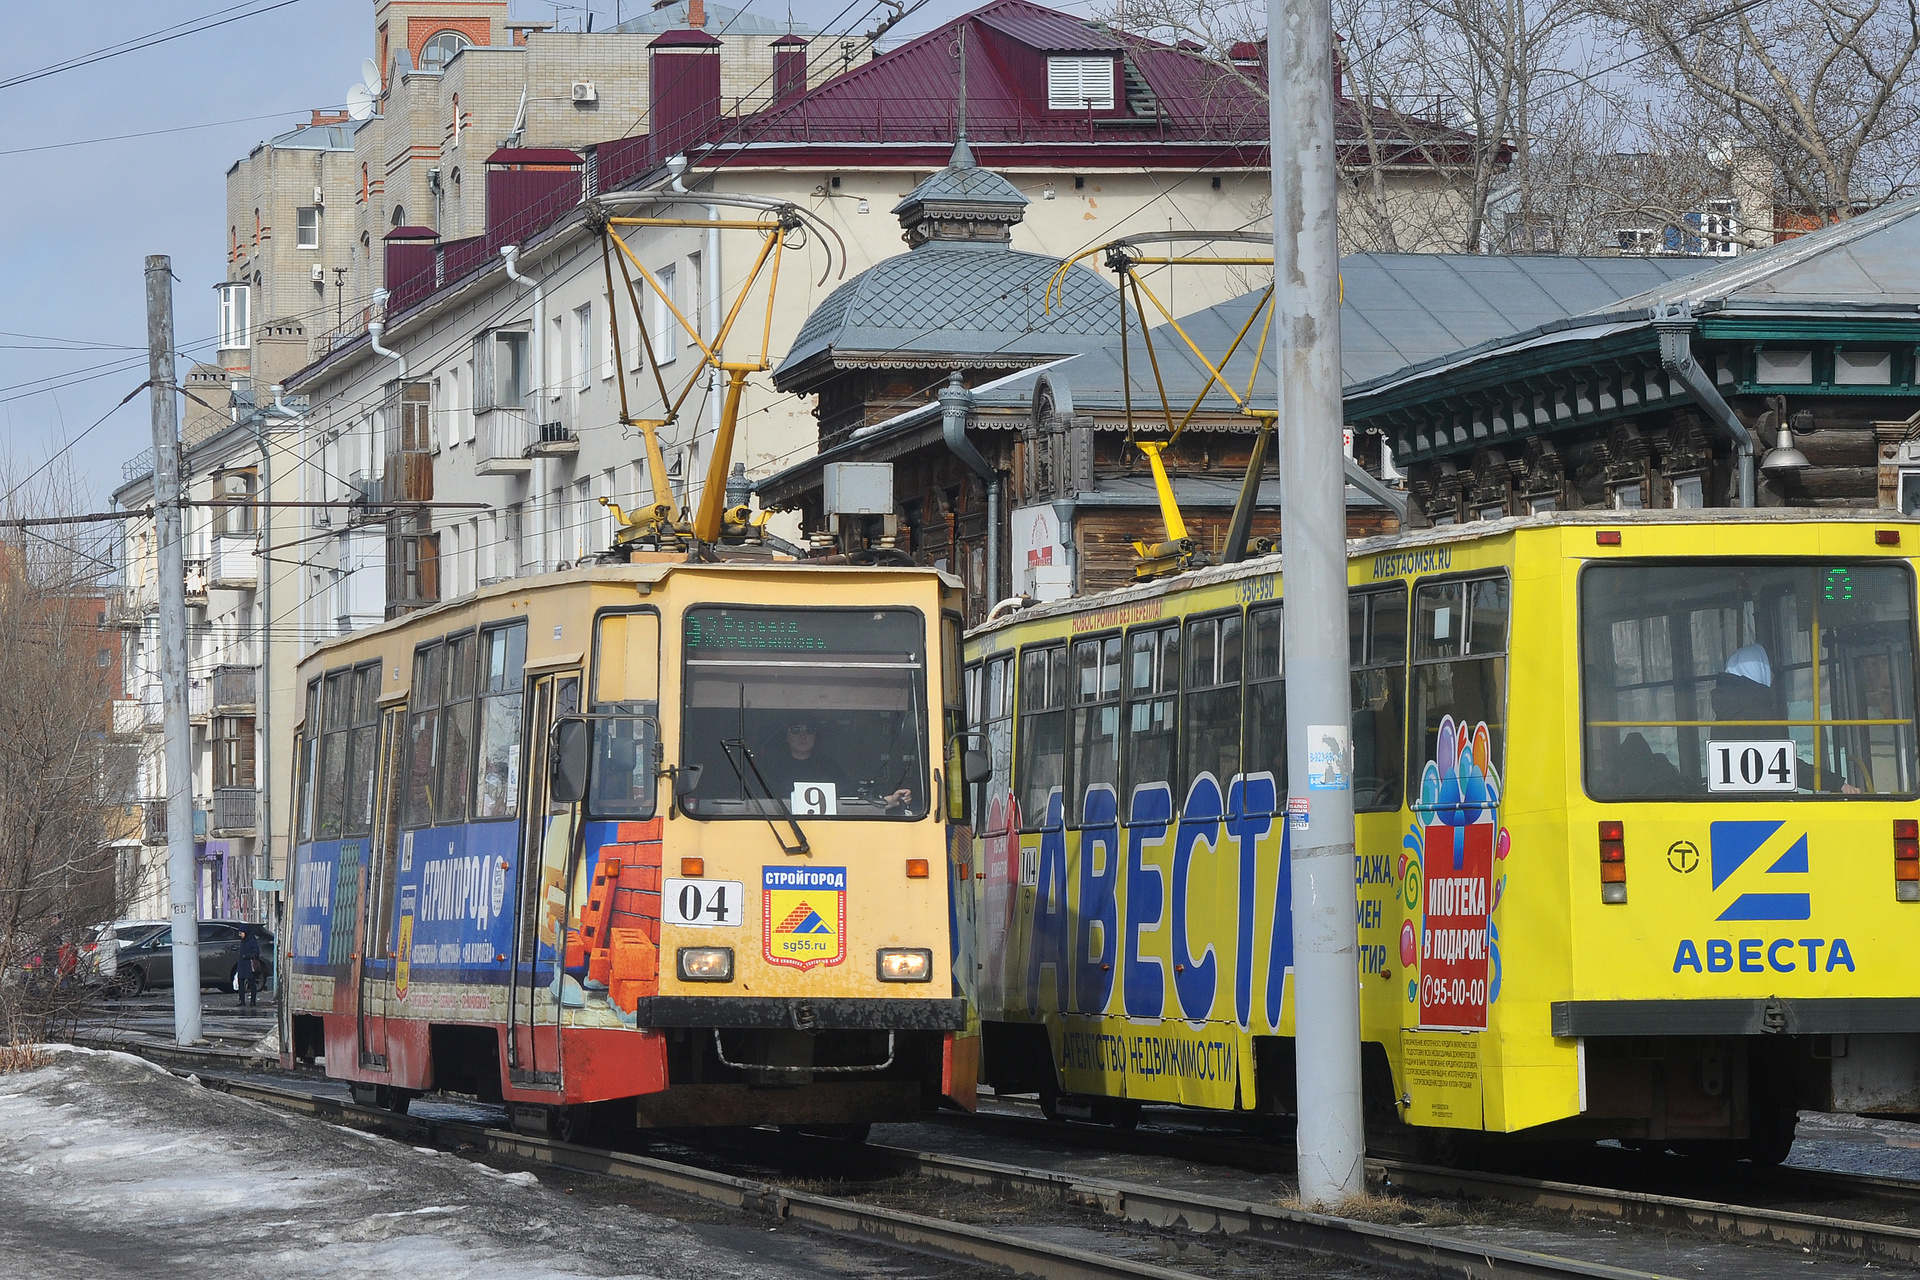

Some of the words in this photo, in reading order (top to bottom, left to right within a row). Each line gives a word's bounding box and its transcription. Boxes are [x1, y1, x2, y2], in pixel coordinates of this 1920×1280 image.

[1373, 547, 1452, 579] AVESTAOMSK.RU
[1242, 575, 1275, 603] 950-950
[1072, 608, 1118, 633] НОВОСТРОЙКИ
[1119, 605, 1131, 625] БЕЗ
[1131, 598, 1163, 623] ПЕРЕПЛАТ
[1716, 746, 1791, 786] 104
[804, 786, 828, 815] 9
[765, 869, 844, 888] СТРОЙГОРОД
[1022, 850, 1036, 884] 104
[421, 841, 491, 931] СТРОЙГОРОД
[1429, 877, 1486, 916] ИПОТЕКА
[678, 884, 730, 924] 04
[783, 940, 827, 952] sg55.ru
[1358, 944, 1387, 973] ТИР
[1424, 928, 1432, 960] В
[1433, 928, 1487, 966] ПОДАРОК!
[1672, 938, 1857, 974] АВЕСТА
[1433, 978, 1485, 1006] 95-00-00
[1062, 1031, 1127, 1074] АГЕНТСТВО
[1130, 1035, 1233, 1084] НЕДВИЖИМОСТИ
